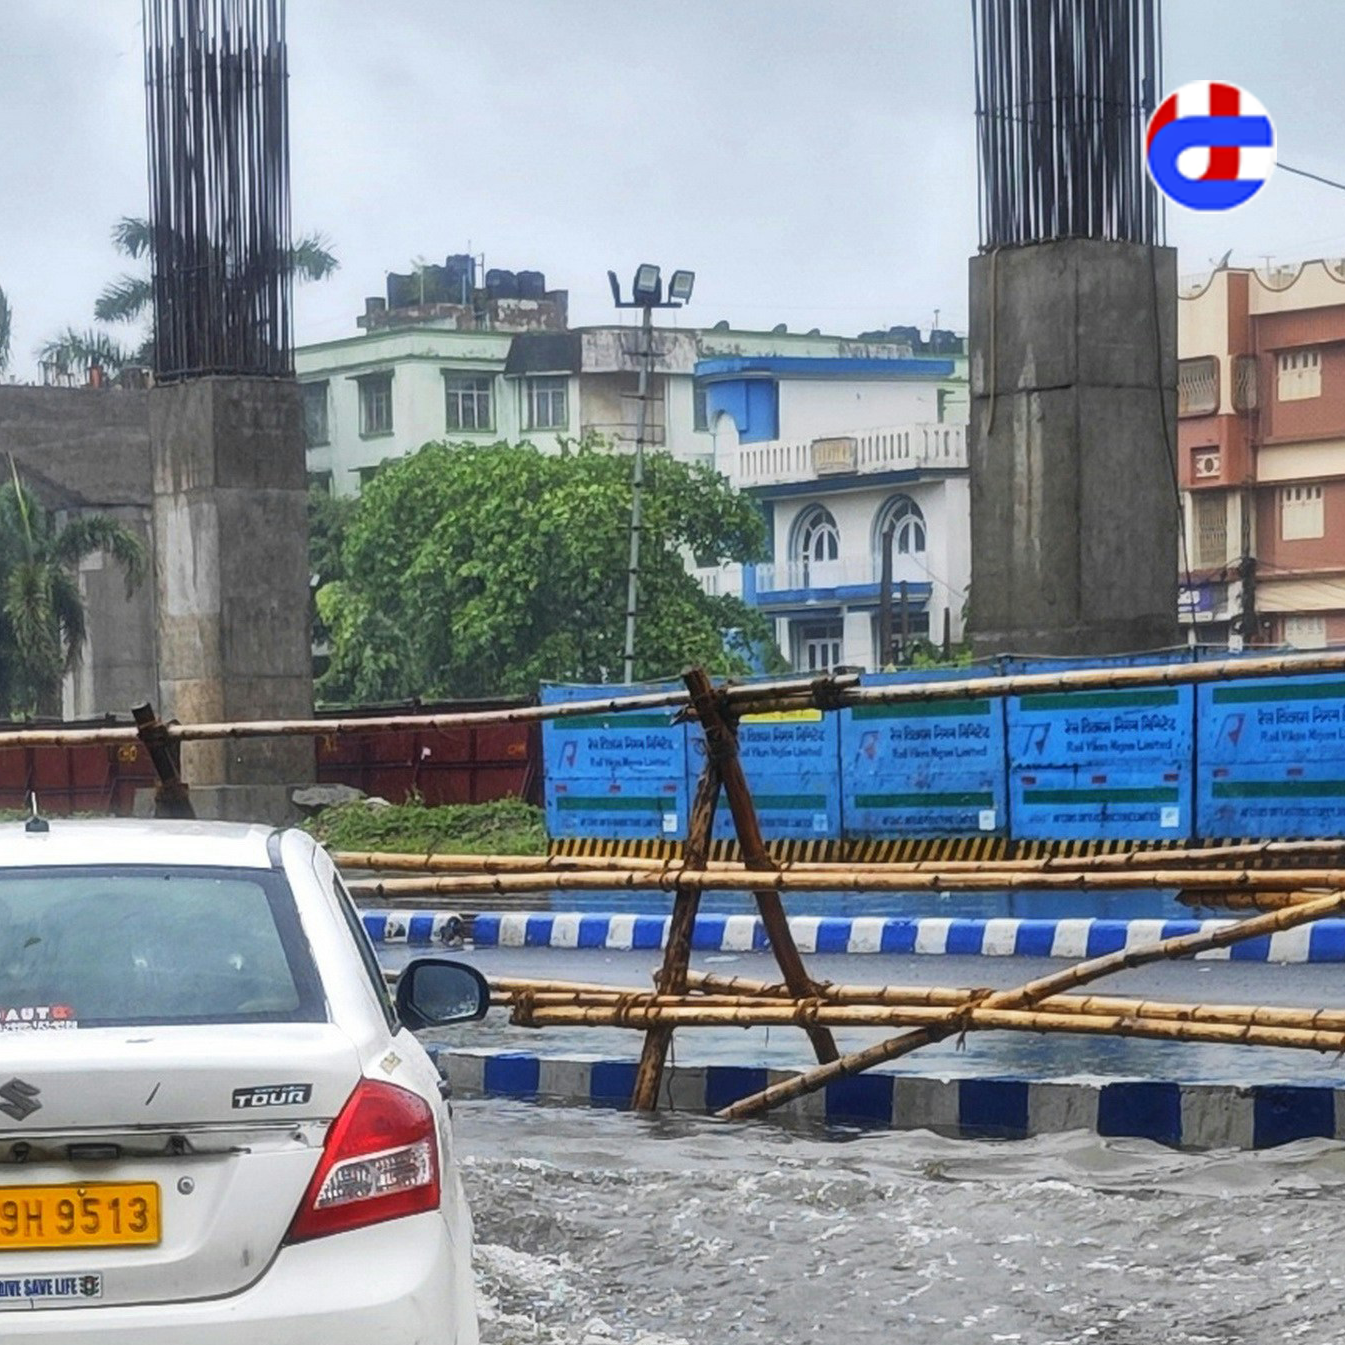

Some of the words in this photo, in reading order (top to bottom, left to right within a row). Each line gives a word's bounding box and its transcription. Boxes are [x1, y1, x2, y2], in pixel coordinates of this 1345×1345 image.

[234, 1090, 305, 1108] TOUR
[56, 1197, 149, 1235] 9513
[23, 1278, 53, 1297] SAVE
[55, 1277, 77, 1295] LIFE
